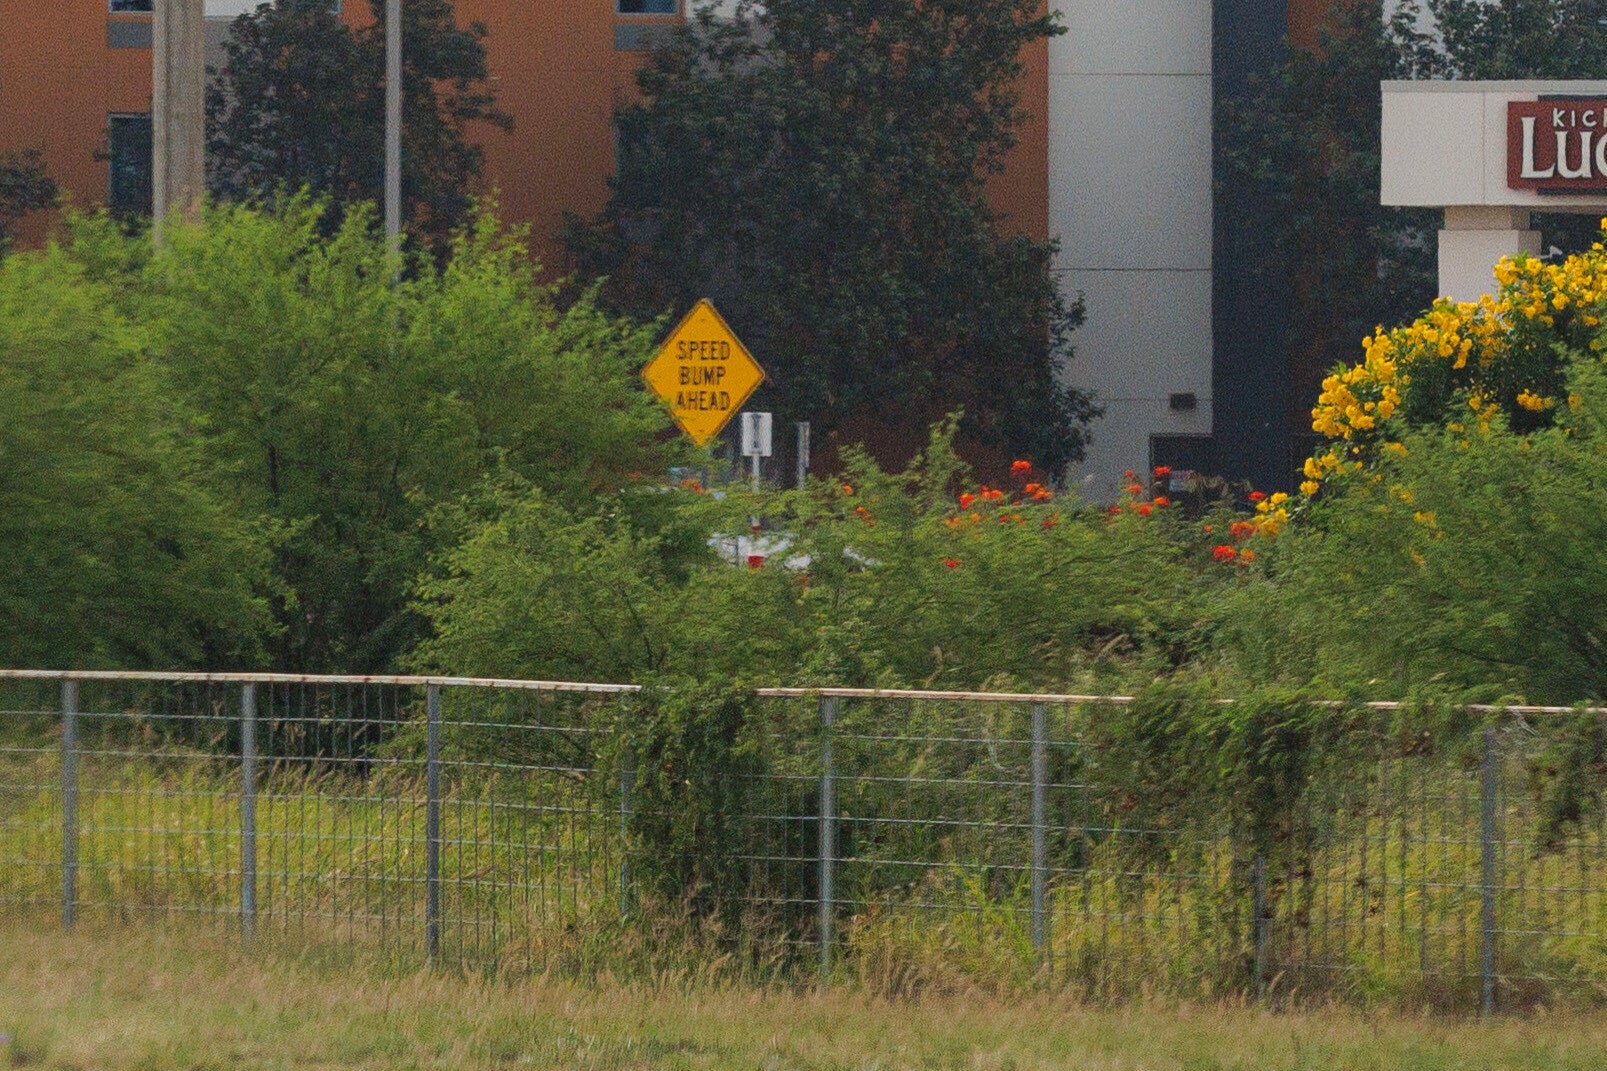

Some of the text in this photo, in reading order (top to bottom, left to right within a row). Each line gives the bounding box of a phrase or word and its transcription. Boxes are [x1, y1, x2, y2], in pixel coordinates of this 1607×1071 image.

[677, 340, 731, 360] SPEED
[680, 366, 727, 385] BUMP
[676, 391, 731, 411] AHEAD
